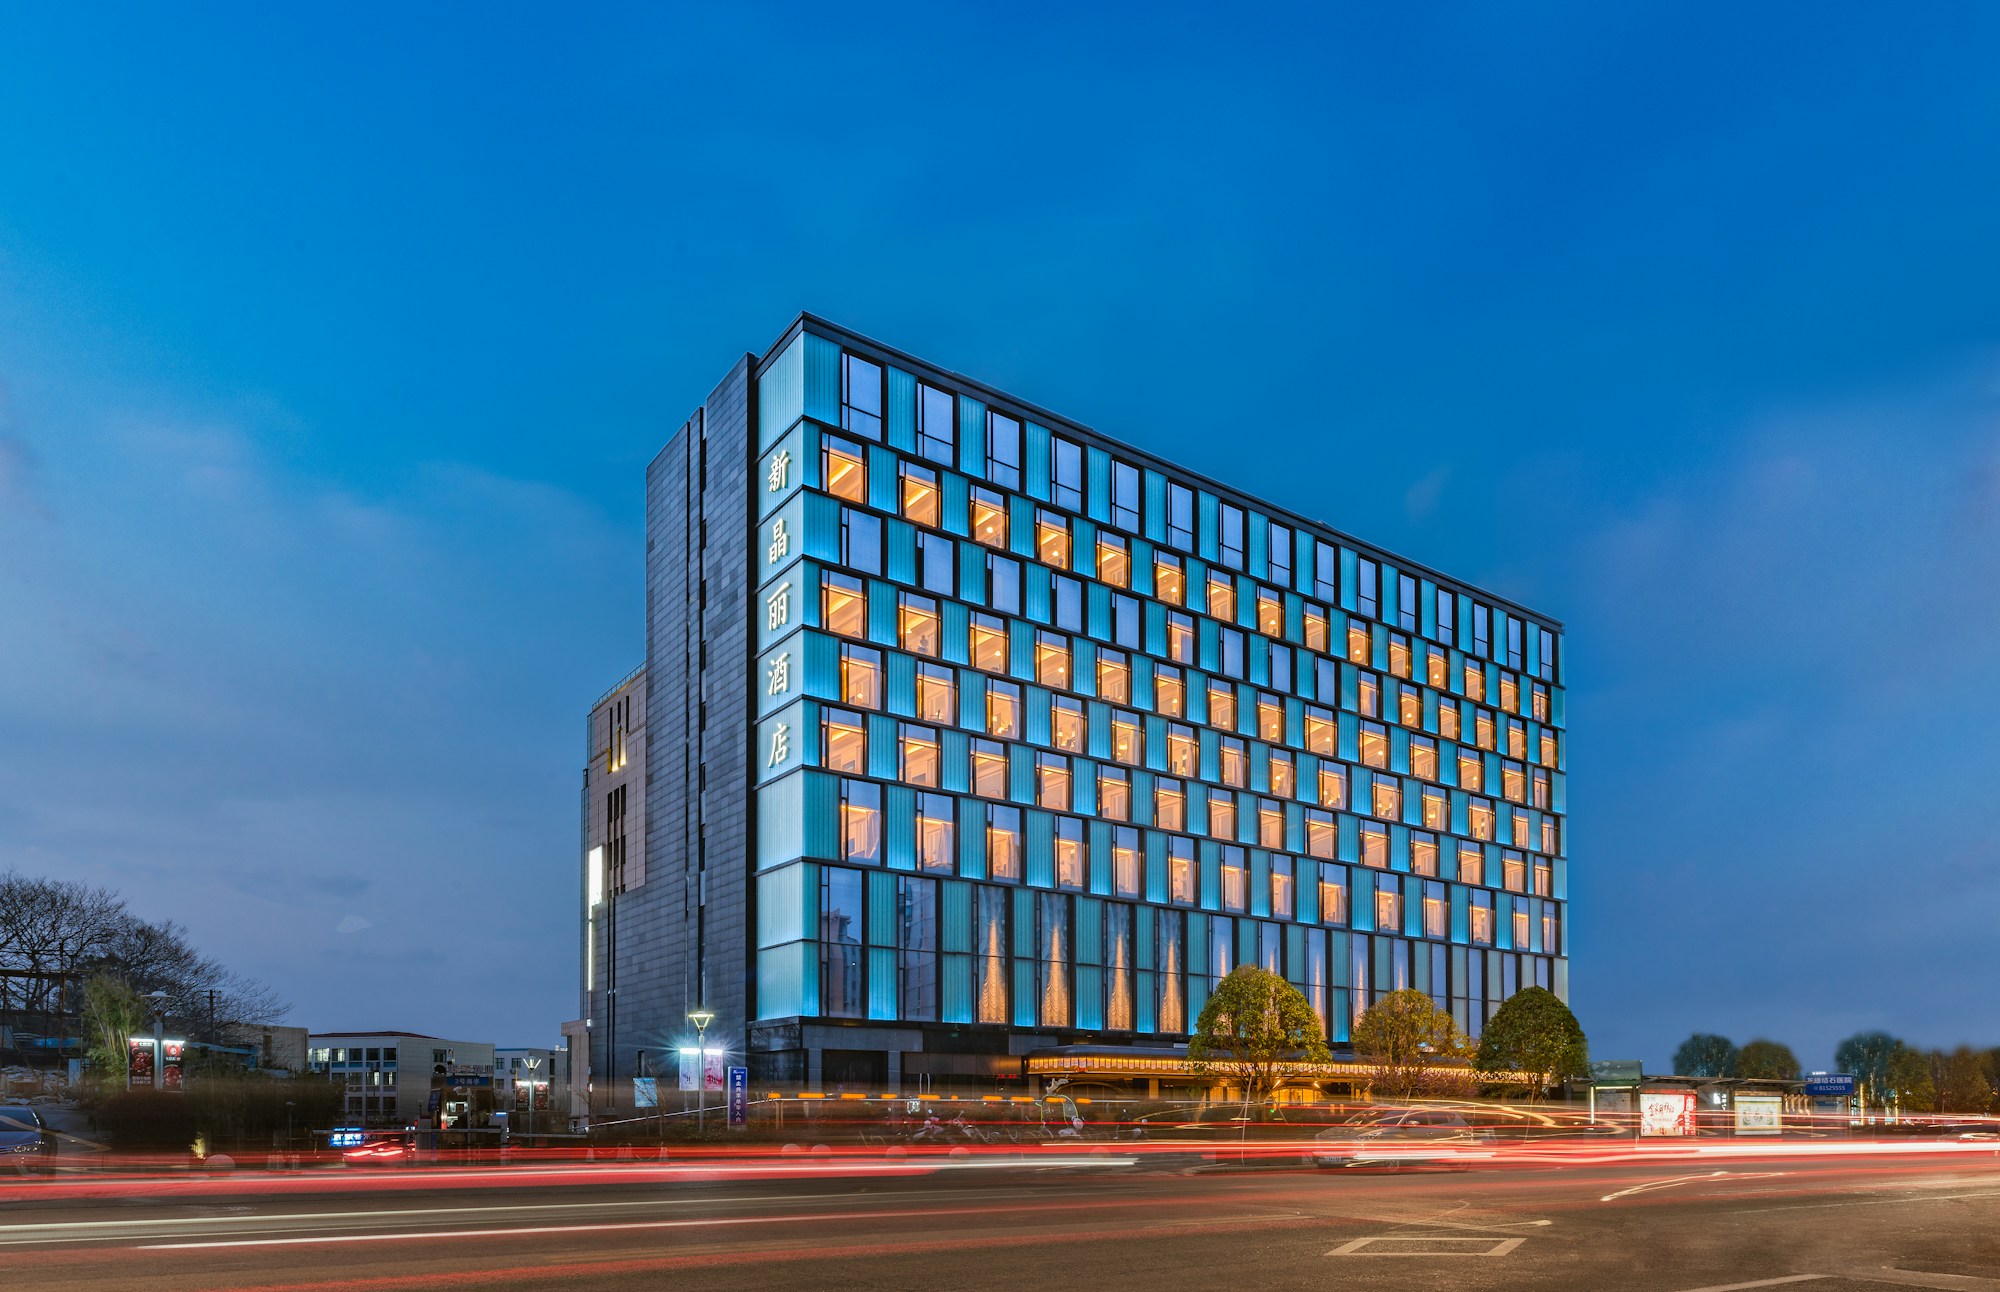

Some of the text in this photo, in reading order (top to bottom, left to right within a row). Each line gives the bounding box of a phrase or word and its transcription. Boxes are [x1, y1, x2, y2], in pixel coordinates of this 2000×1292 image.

[767, 450, 791, 768] 新晶丽酒店
